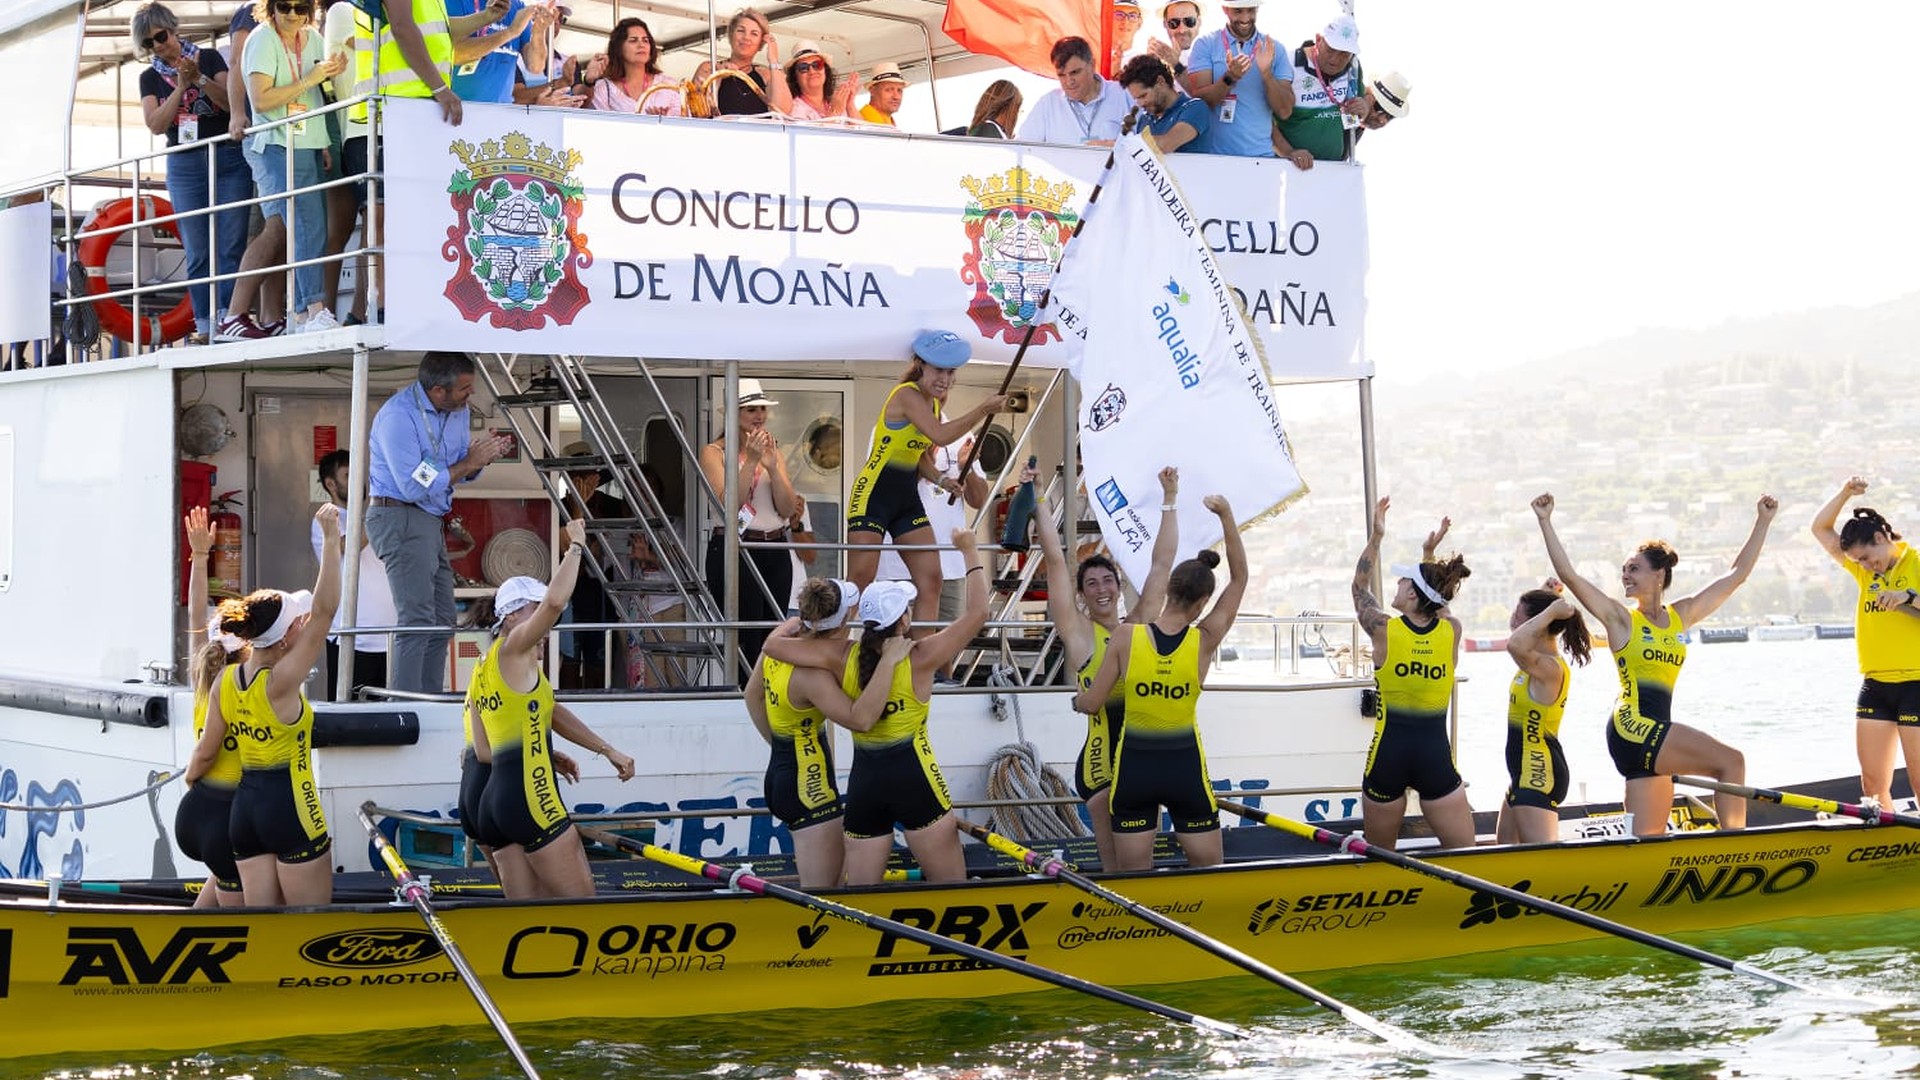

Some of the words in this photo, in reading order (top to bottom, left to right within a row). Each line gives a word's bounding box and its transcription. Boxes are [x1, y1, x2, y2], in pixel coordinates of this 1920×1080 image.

[611, 172, 860, 235] CONCELLO
[1200, 217, 1320, 257] CELLO
[1139, 158, 1196, 239] BANDEIRA
[1198, 244, 1235, 335] FEMININA
[1233, 340, 1250, 367] DE
[613, 261, 671, 301] DE
[691, 253, 890, 308] MOAÑA
[1058, 306, 1074, 330] DE
[1151, 301, 1201, 391] aqualia
[1114, 516, 1144, 553] LIGA
[1126, 507, 1151, 542] euskotren
[1394, 660, 1446, 680] ORIO!
[1135, 681, 1190, 700] ORIO!
[229, 720, 274, 743] ORIO!
[1526, 709, 1542, 744] ORIO
[1618, 704, 1650, 738] ORIALKI
[1529, 750, 1546, 788] ORIALKI
[301, 780, 325, 831] ORIALKI
[531, 765, 562, 822] ORIALKI
[1120, 819, 1147, 829] ORIO
[1669, 852, 1750, 867] TRANSPORTES
[1639, 858, 1819, 907] INDO
[1292, 887, 1424, 913] SETALDE
[597, 921, 737, 955] ORIO
[875, 901, 1049, 958] PBX
[1281, 911, 1387, 934] GROUP
[58, 926, 249, 985] AVK
[327, 933, 426, 963] Ford
[766, 953, 834, 969] novadiet
[278, 976, 353, 989] EASO
[591, 953, 727, 980] kanpina
[880, 959, 995, 975] PALIBEX.C
[72, 983, 223, 996] www.avkvalvulas.com
